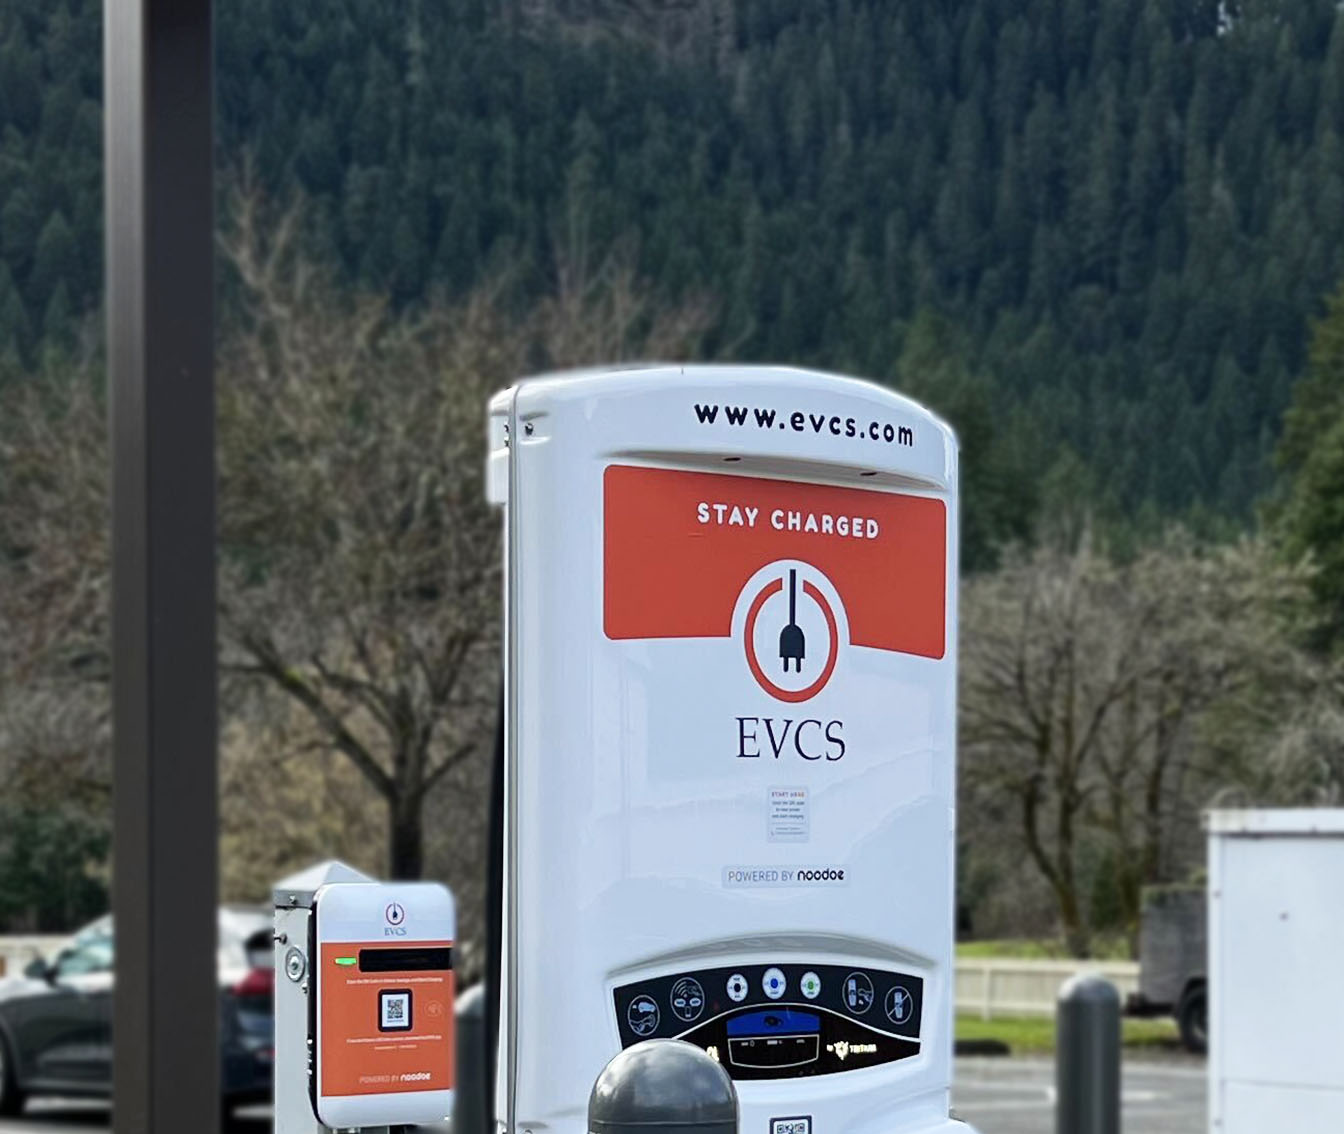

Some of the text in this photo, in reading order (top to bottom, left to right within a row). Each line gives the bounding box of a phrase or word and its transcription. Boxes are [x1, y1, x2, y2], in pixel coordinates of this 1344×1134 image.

[694, 403, 914, 447] www.evcs.com
[697, 502, 879, 540] STAY CHARGED
[735, 716, 847, 761] EVCS
[728, 867, 845, 882] POWERED BY noodoe
[384, 927, 408, 936] EVCS
